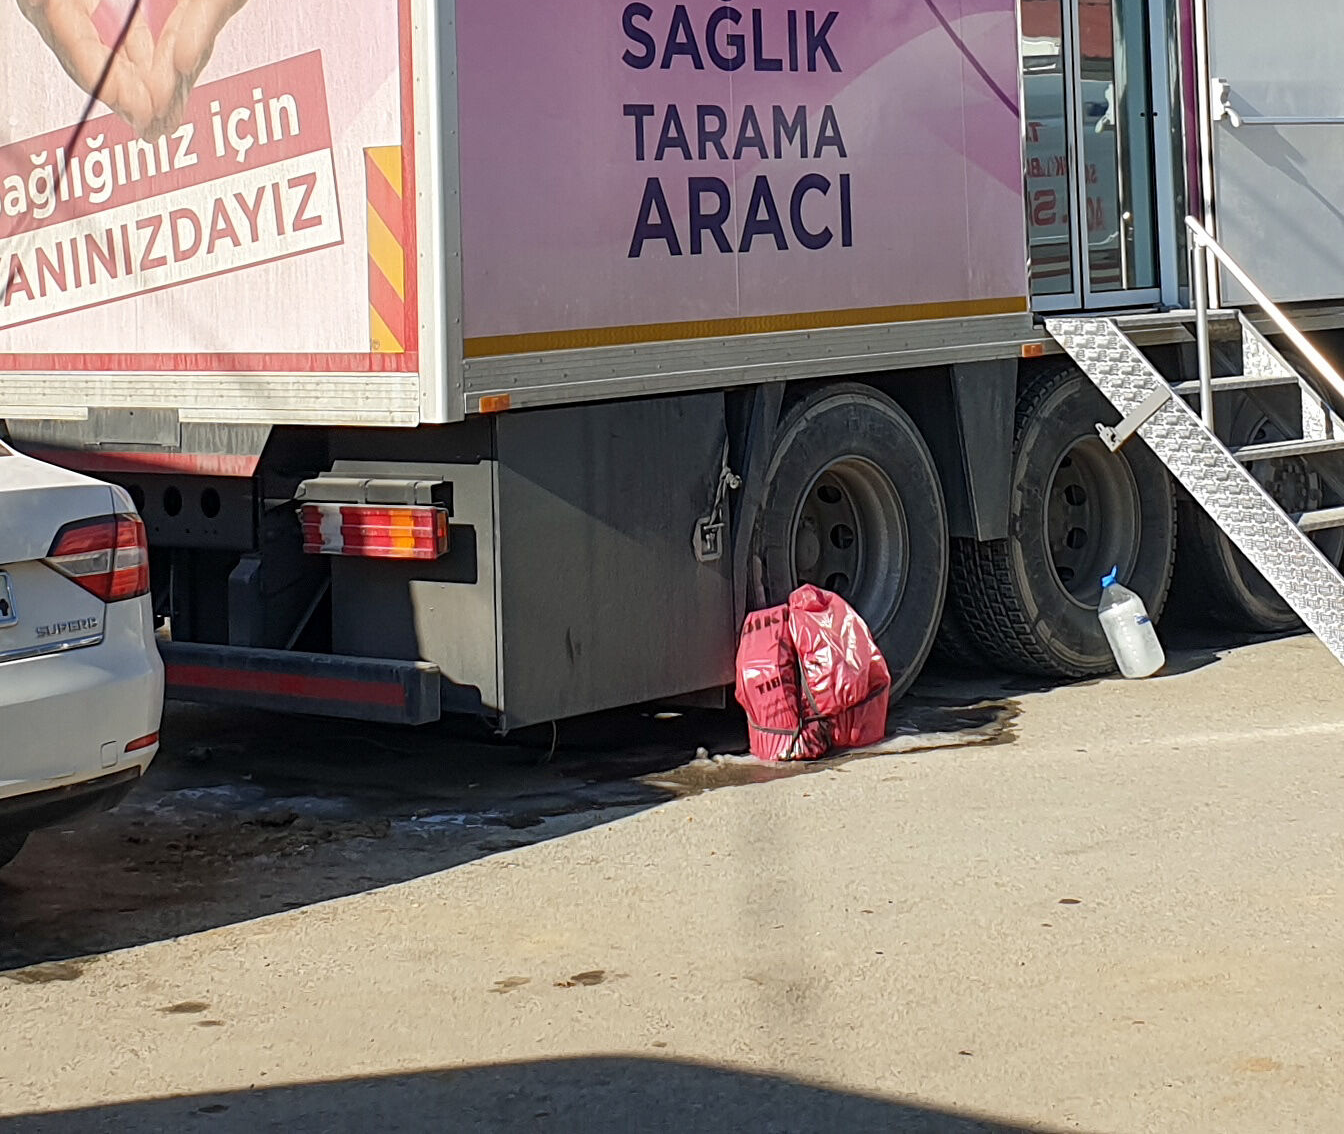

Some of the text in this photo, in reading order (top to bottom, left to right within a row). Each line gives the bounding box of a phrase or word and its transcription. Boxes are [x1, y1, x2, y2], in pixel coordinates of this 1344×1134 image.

[209, 87, 301, 163] için
[622, 103, 848, 161] TARAMA
[627, 173, 853, 258] ARACI
[35, 617, 99, 638] SUPERB
